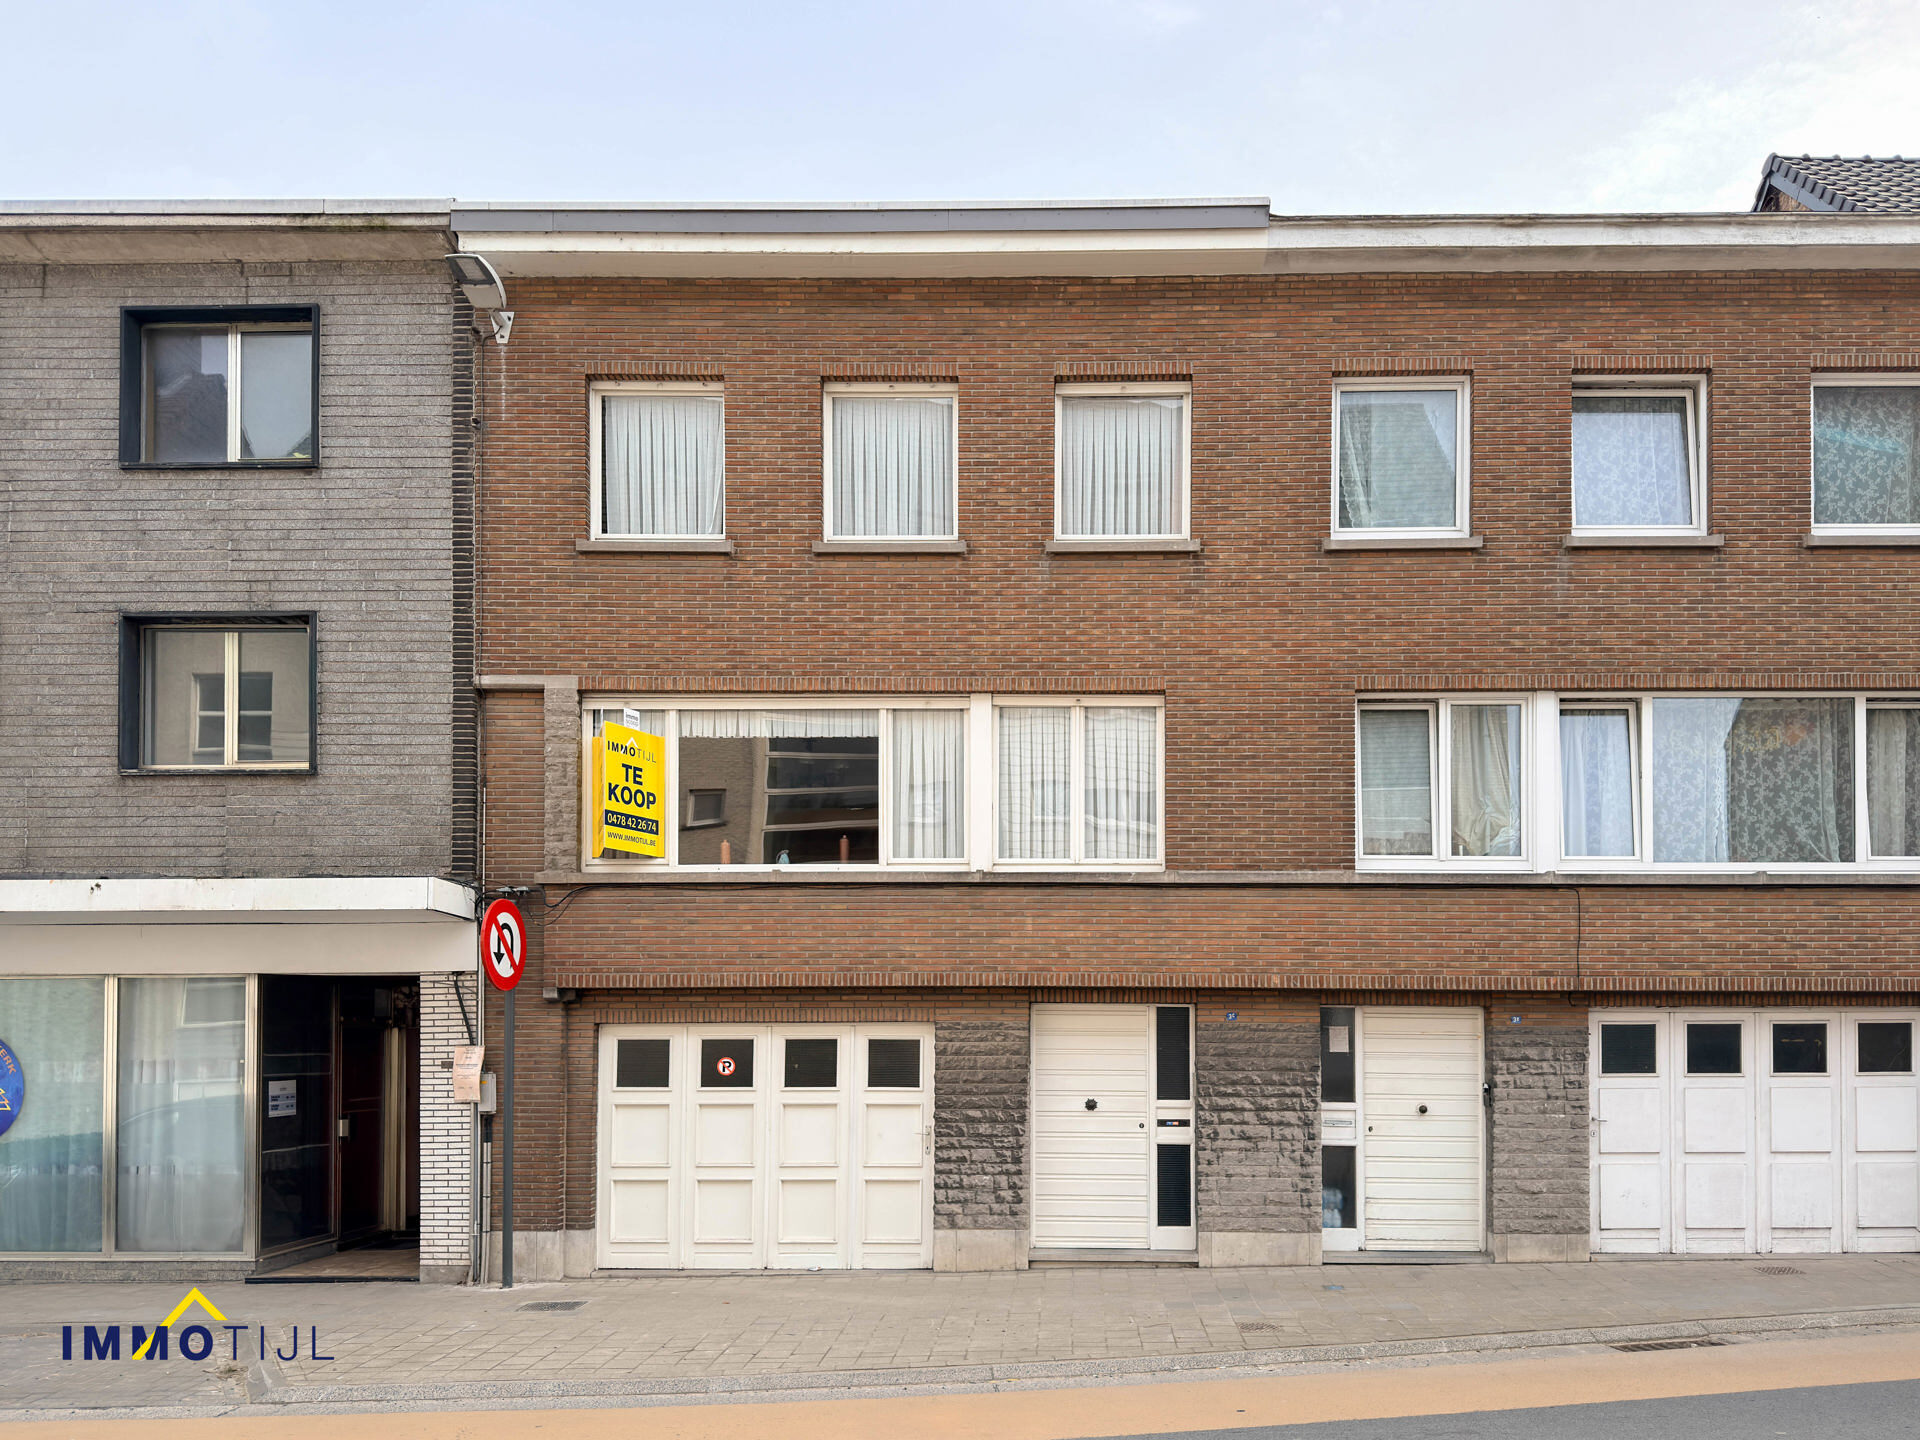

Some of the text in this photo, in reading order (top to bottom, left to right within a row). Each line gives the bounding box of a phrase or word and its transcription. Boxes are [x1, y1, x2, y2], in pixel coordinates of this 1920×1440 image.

[608, 740, 656, 763] IMMOTIJL
[622, 763, 643, 786] TE
[608, 782, 656, 810] KOOP
[608, 813, 656, 832] 0478 42 26 74
[0, 1045, 17, 1075] ERK
